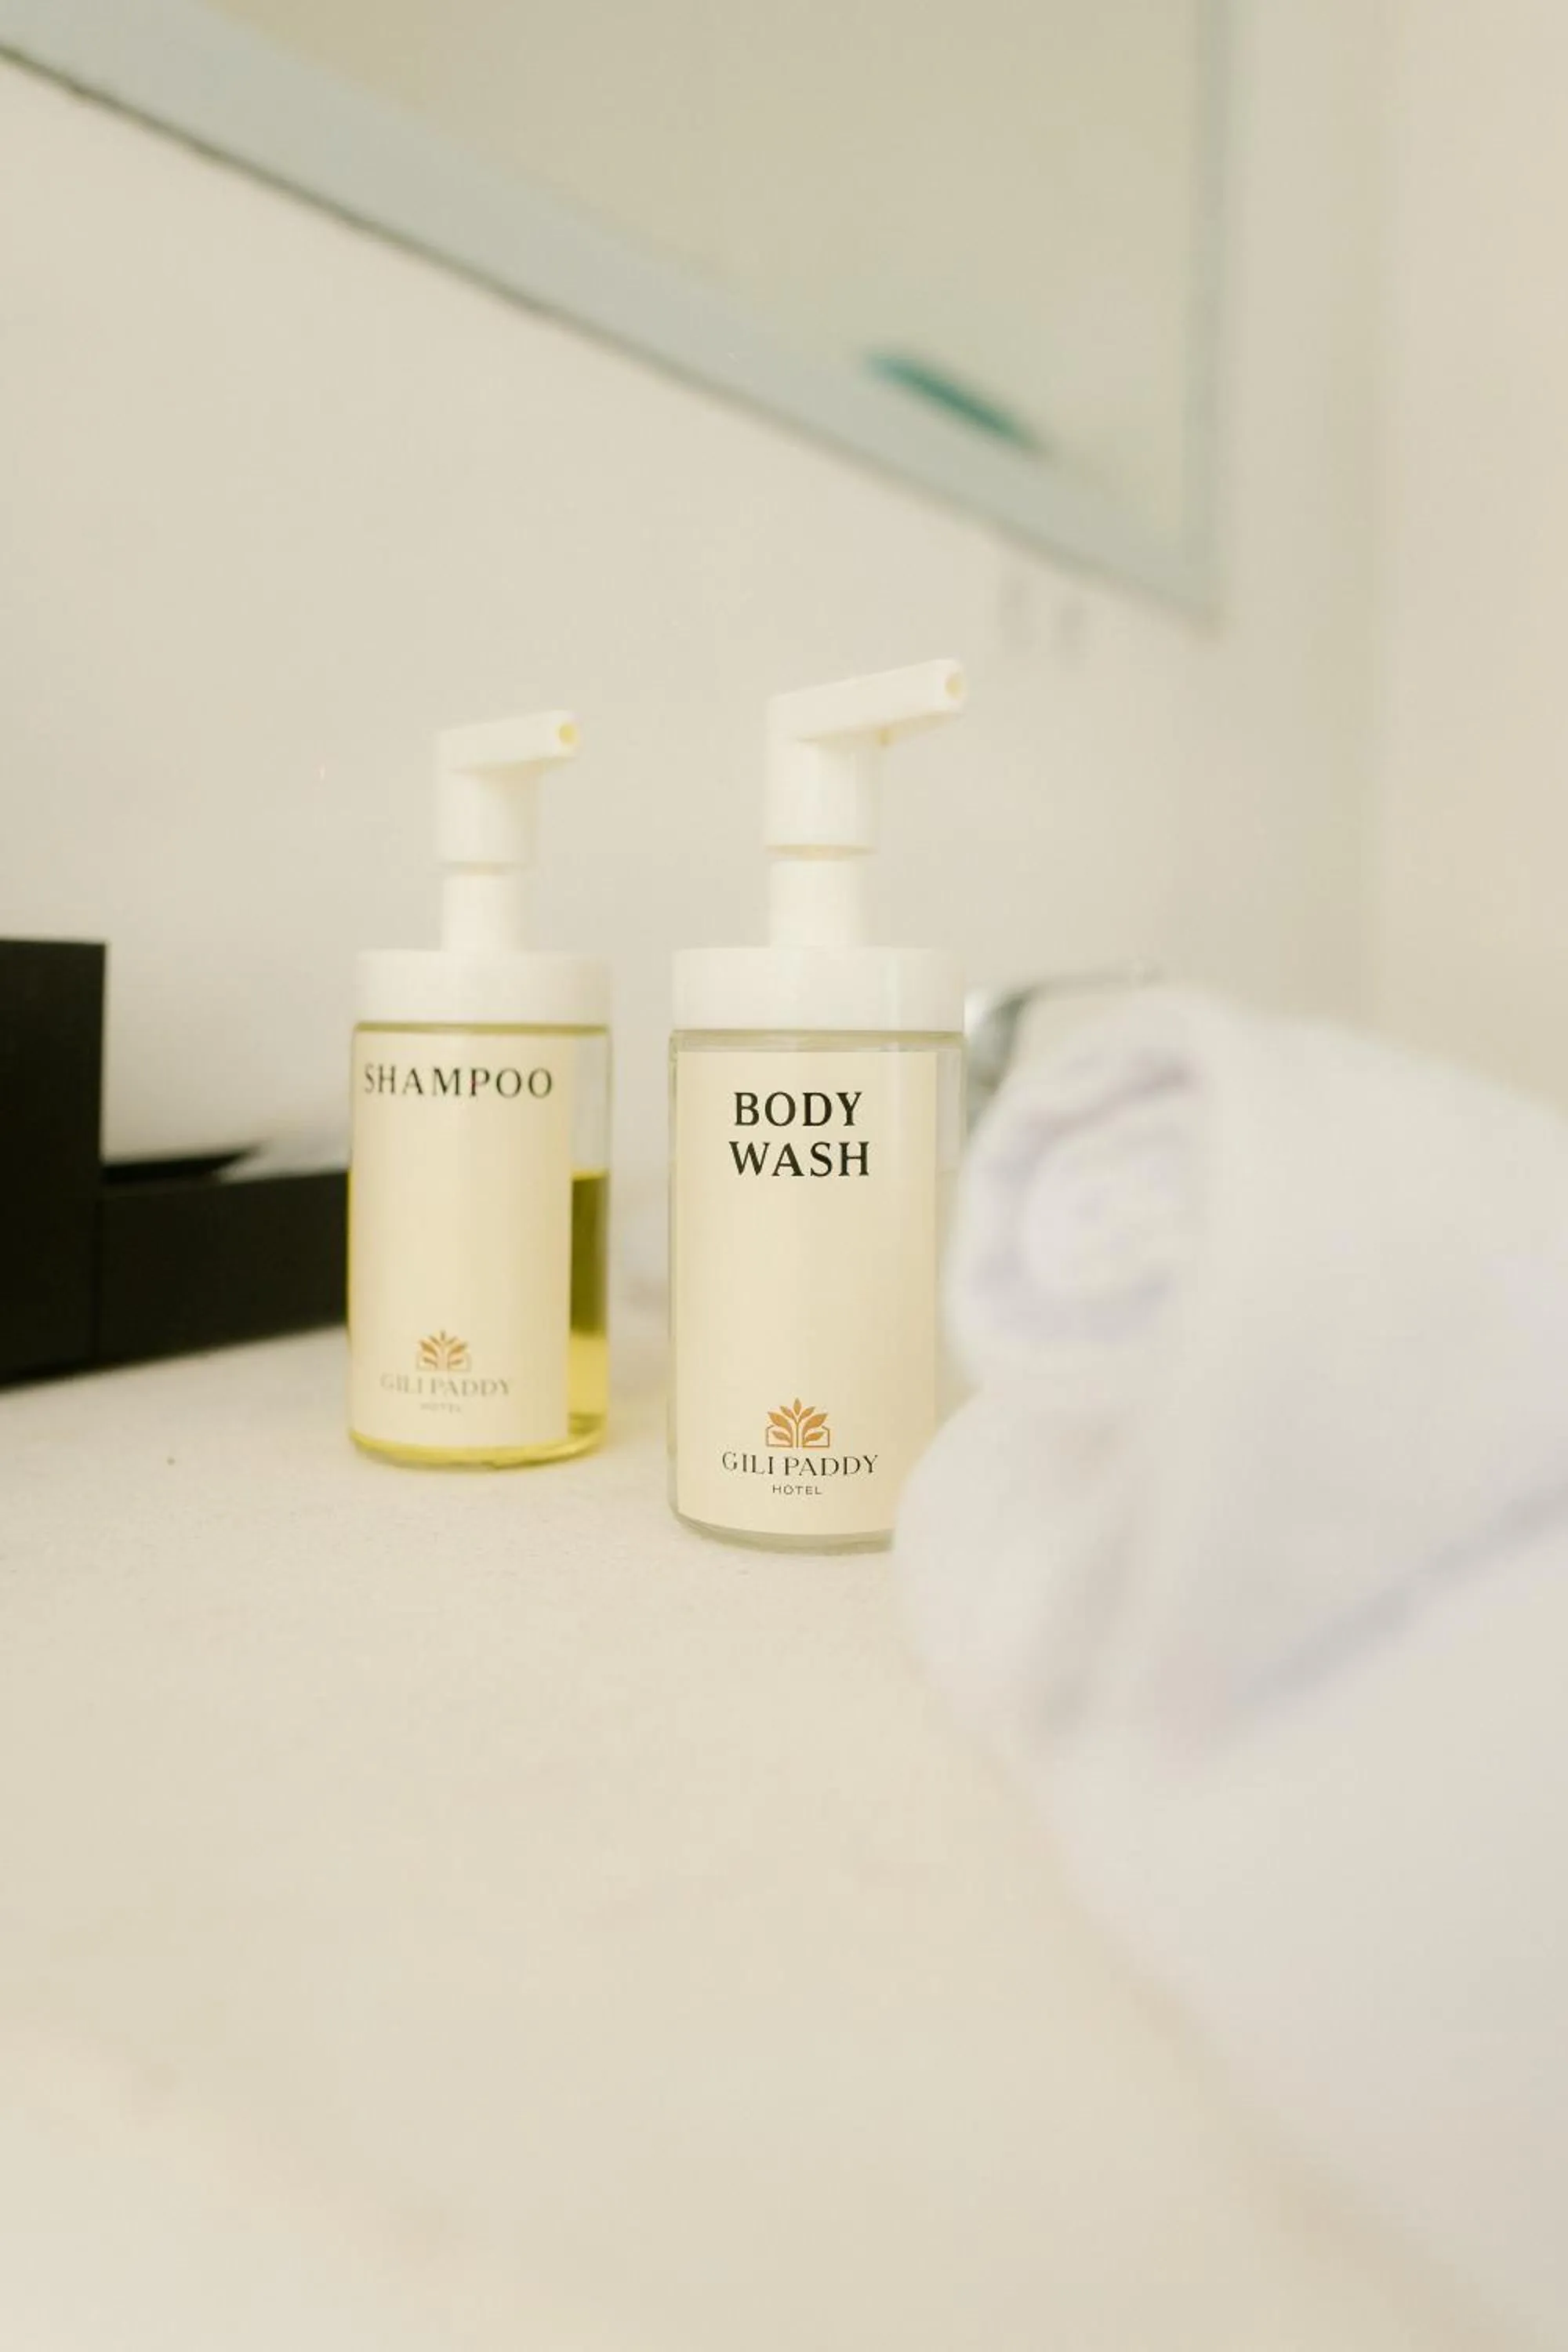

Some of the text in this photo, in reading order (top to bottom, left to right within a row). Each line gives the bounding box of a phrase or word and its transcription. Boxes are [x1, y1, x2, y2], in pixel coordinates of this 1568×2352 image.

[363, 1062, 553, 1099] SHAMPOO
[733, 1091, 863, 1127] BODY
[728, 1141, 870, 1177] WASH
[430, 1376, 513, 1398] PADDY
[721, 1451, 879, 1476] GILI PADDY
[771, 1484, 823, 1496] HOTEL
